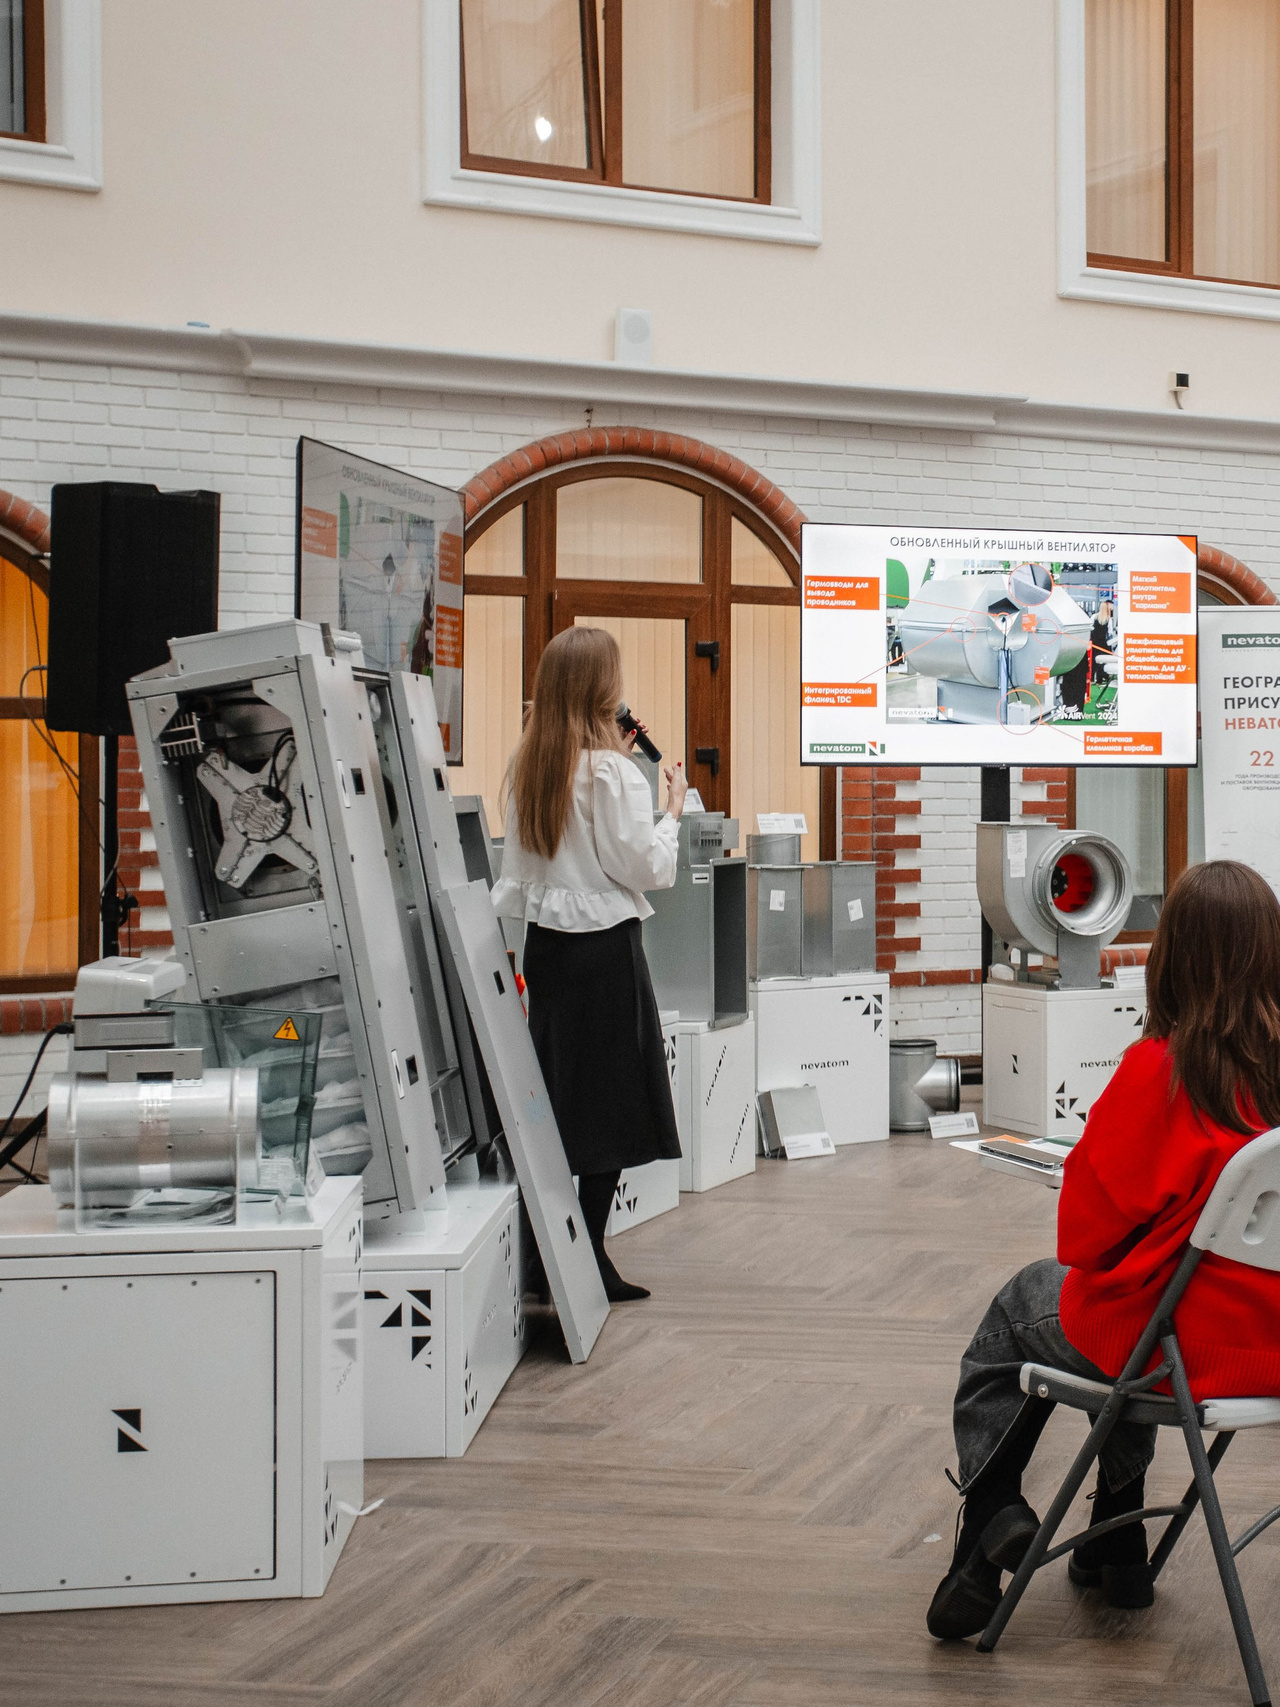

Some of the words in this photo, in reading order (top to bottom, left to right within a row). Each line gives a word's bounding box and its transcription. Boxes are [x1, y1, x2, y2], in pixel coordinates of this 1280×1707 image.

[890, 536, 980, 549] ОБНОВЛЕННЫЙ
[984, 539, 1044, 551] КРЫШНЫЙ
[1047, 541, 1116, 553] ВЕНТИЛЯТОР
[855, 581, 869, 590] для
[1132, 584, 1176, 593] уплотнитель
[806, 589, 836, 598] вывода
[1132, 594, 1157, 602] внутри
[806, 598, 857, 607] проводников
[1126, 637, 1184, 646] Межфланцевый
[1126, 646, 1170, 655] уплотнитель
[1171, 647, 1184, 655] для
[1126, 655, 1182, 663] общеобменной
[1126, 664, 1159, 672] системы.
[1161, 664, 1174, 672] Для
[804, 686, 872, 695] Интегрированный
[804, 695, 836, 705] фланец
[836, 696, 852, 704] TDC
[1086, 735, 1133, 744] Герметичная
[813, 744, 863, 752] nevatom
[1123, 744, 1154, 752] коробка
[1249, 750, 1275, 767] 22
[801, 1058, 850, 1071] nevatom
[1080, 1059, 1120, 1068] nevato
